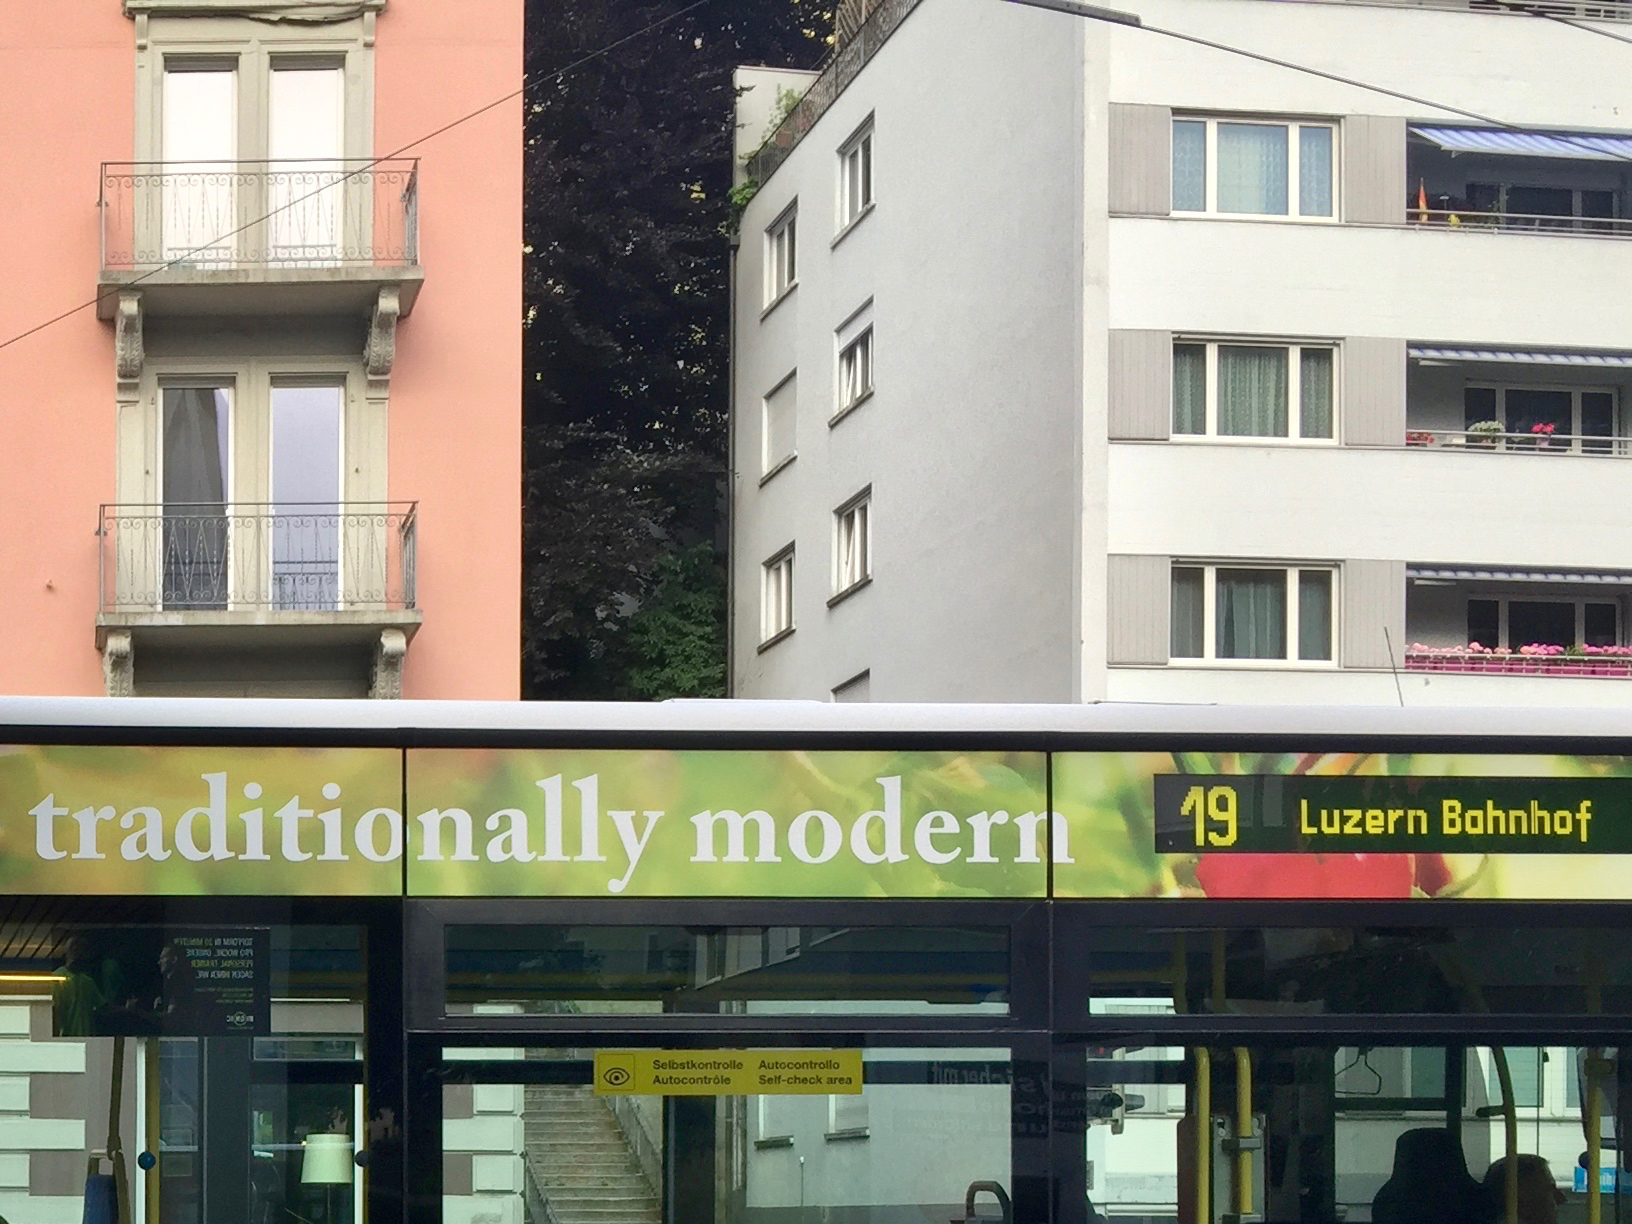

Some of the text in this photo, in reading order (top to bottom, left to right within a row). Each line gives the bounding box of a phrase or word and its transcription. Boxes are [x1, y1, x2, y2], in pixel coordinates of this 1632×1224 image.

[29, 771, 665, 893] traditionally
[691, 775, 1075, 865] modern
[1180, 786, 1593, 847] 19 Luzern Bahnhof
[652, 1059, 840, 1070] Selbstkontrolle Autocontrollo
[652, 1074, 853, 1086] Autocontrôle Self-check area
